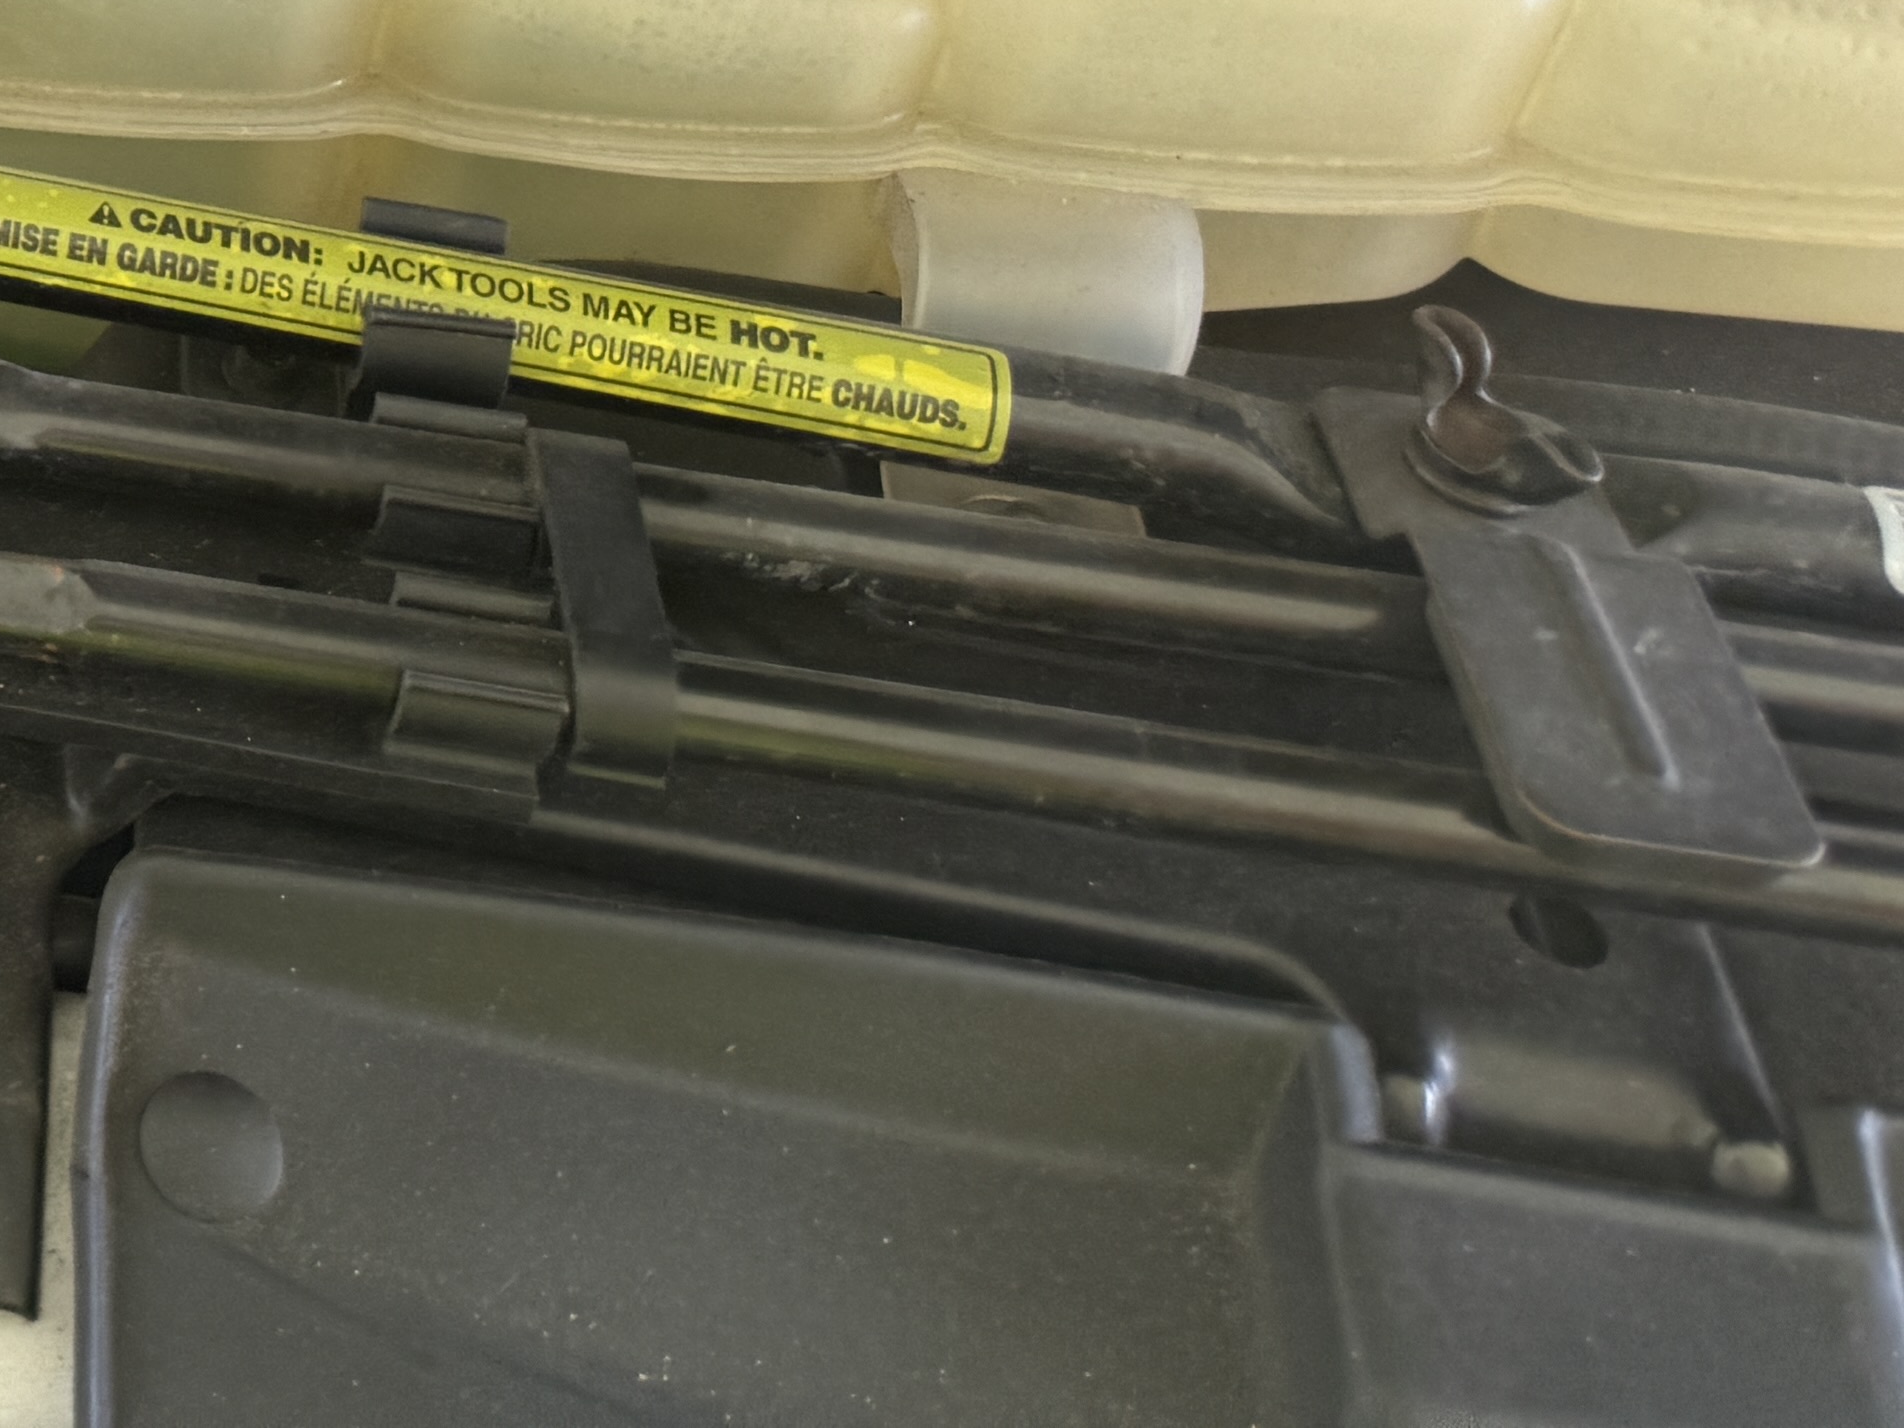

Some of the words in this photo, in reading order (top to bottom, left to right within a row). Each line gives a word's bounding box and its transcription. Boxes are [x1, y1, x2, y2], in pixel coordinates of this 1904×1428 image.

[67, 232, 108, 266] EN
[117, 242, 220, 288] GARDE
[240, 267, 294, 303] DES
[569, 328, 747, 393] POURRAIENT
[752, 357, 823, 403] ÊTRE
[830, 377, 968, 432] CHAUDS.
[129, 206, 324, 266] CAUTION:
[346, 250, 442, 290] JACK
[451, 268, 571, 314] TOOLS
[582, 292, 657, 328] MAY
[669, 308, 718, 341] BE
[729, 319, 825, 361] HOT.
